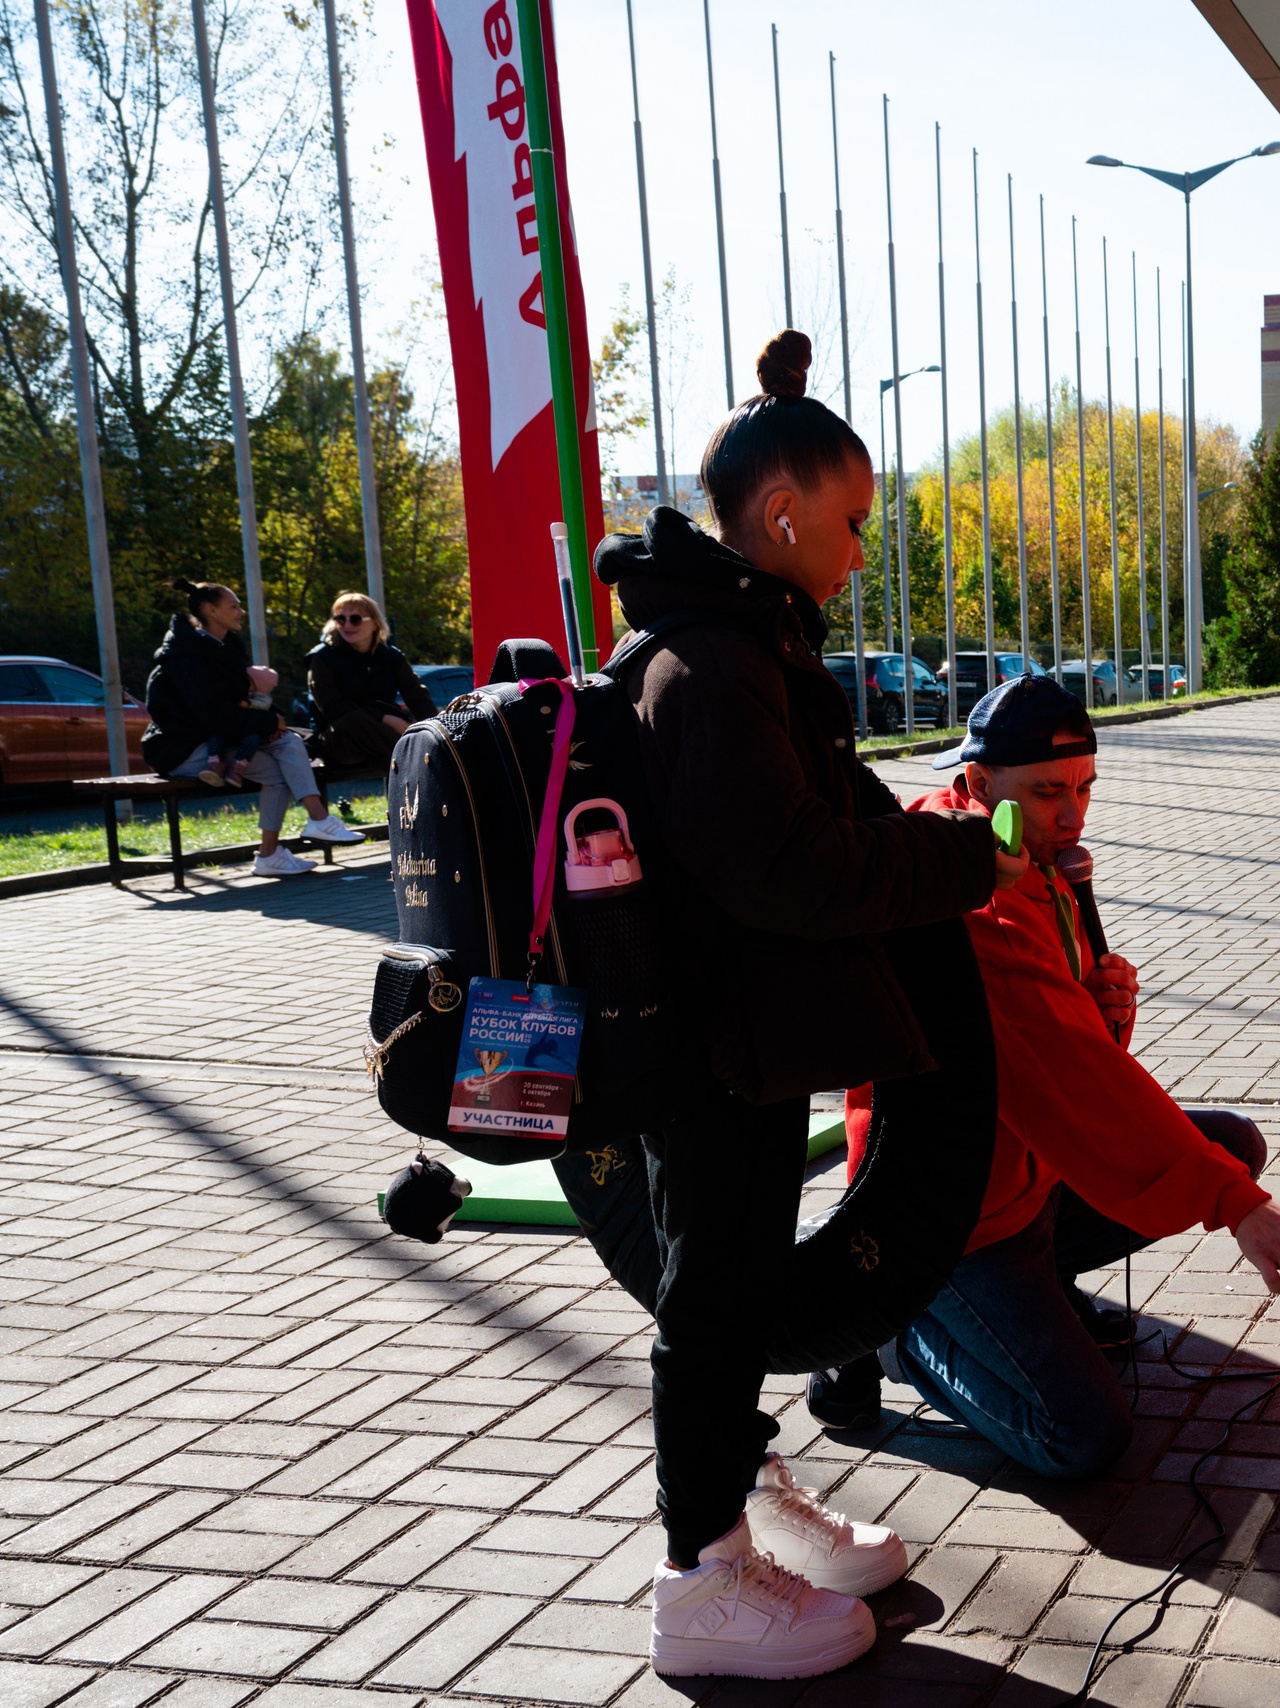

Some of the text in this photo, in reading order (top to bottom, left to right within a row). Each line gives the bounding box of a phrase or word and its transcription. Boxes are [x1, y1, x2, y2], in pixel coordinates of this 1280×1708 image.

[472, 1007, 522, 1019] АЛЬФА-БАНК
[559, 1016, 578, 1024] ЛИГА
[471, 1016, 576, 1036] КУБОК КЛУБОВ
[469, 1028, 525, 1043] РОССИИ
[532, 1083, 559, 1092] сентября
[463, 1112, 554, 1130] УЧАСТНИЦА
